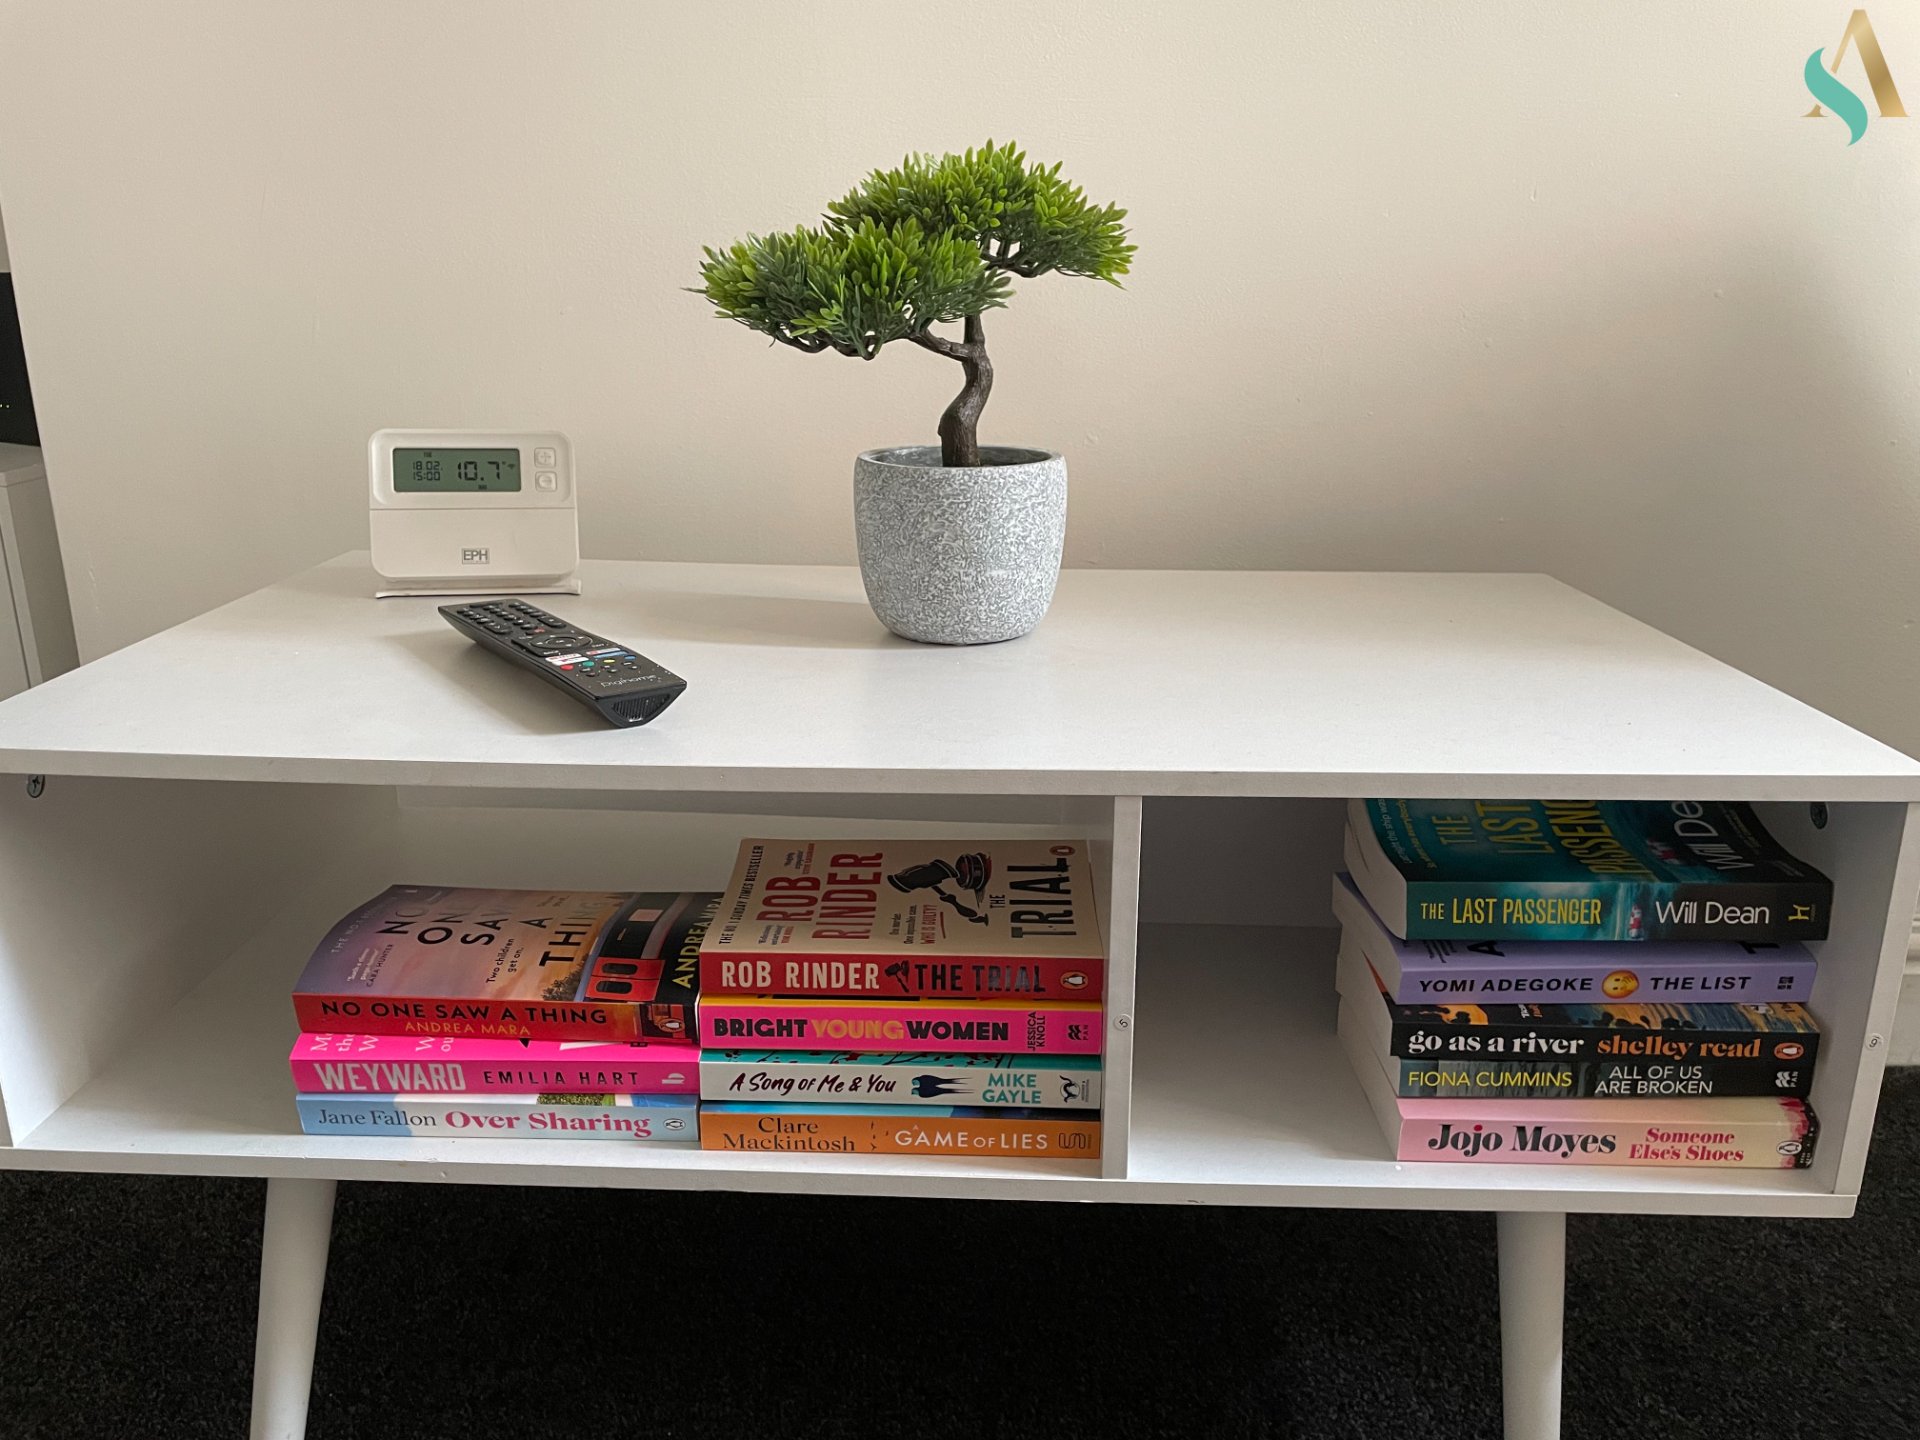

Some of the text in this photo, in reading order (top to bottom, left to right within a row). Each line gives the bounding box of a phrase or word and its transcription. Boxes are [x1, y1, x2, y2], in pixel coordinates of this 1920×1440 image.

[413, 472, 440, 480] 15:00
[464, 550, 488, 560] EPH
[1475, 800, 1555, 853] LAST
[1672, 800, 1719, 836] De
[1432, 816, 1477, 845] THE
[745, 845, 764, 882] BESTSELLER
[1687, 843, 1754, 870] Will
[739, 883, 754, 900] TIMES
[756, 876, 820, 921] ROB
[812, 852, 883, 939] RINDER
[989, 894, 1005, 908] THE
[1007, 857, 1077, 938] TRIAL
[730, 900, 748, 920] SUNDAY
[1420, 898, 1602, 925] THE LAST PASSENGER
[1655, 901, 1770, 924] Will Dean
[518, 917, 553, 929] A
[719, 933, 734, 944] THE
[374, 944, 393, 968] HUNTER
[486, 938, 515, 984] Two children
[507, 958, 519, 973] get
[672, 921, 712, 989] ANDREA
[721, 961, 880, 990] ROB RINDER
[914, 964, 1046, 992] THE TRIAL
[1419, 978, 1594, 993] YOMI ADEGOKE
[1650, 976, 1752, 990] THE LIST
[321, 1001, 608, 1024] NO ONE SAW A THING
[405, 1022, 532, 1036] ANDREA MARA
[714, 1018, 1009, 1041] BRIGHT YOUNG WOMEN
[1027, 1011, 1036, 1051] JESSICA
[1036, 1015, 1046, 1048] KNOLL
[1408, 1030, 1584, 1054] go as a river
[1597, 1034, 1762, 1061] shelley read
[313, 1063, 639, 1091] WEYWARD EMILIA HART
[728, 1072, 746, 1092] A
[749, 1072, 796, 1096] Song
[816, 1074, 845, 1093] Me
[848, 1076, 862, 1092] &
[866, 1074, 897, 1093] You
[988, 1073, 1037, 1088] MIKE
[1408, 1072, 1573, 1088] FIONA CUMMINS
[1609, 1066, 1702, 1079] ALL OF US
[1790, 1071, 1798, 1088] PAN
[982, 1090, 1042, 1104] GAYLE
[1594, 1080, 1713, 1094] ARE BROKEN
[318, 1109, 652, 1138] Jane Fallon Over Sharing
[758, 1116, 819, 1134] Clare
[723, 1133, 856, 1151] Mackintosh
[895, 1130, 1048, 1150] GAME OF LIES
[1428, 1124, 1616, 1159] Jojo Moyes
[1645, 1128, 1735, 1144] Someone
[1689, 1144, 1744, 1162] Shoes
